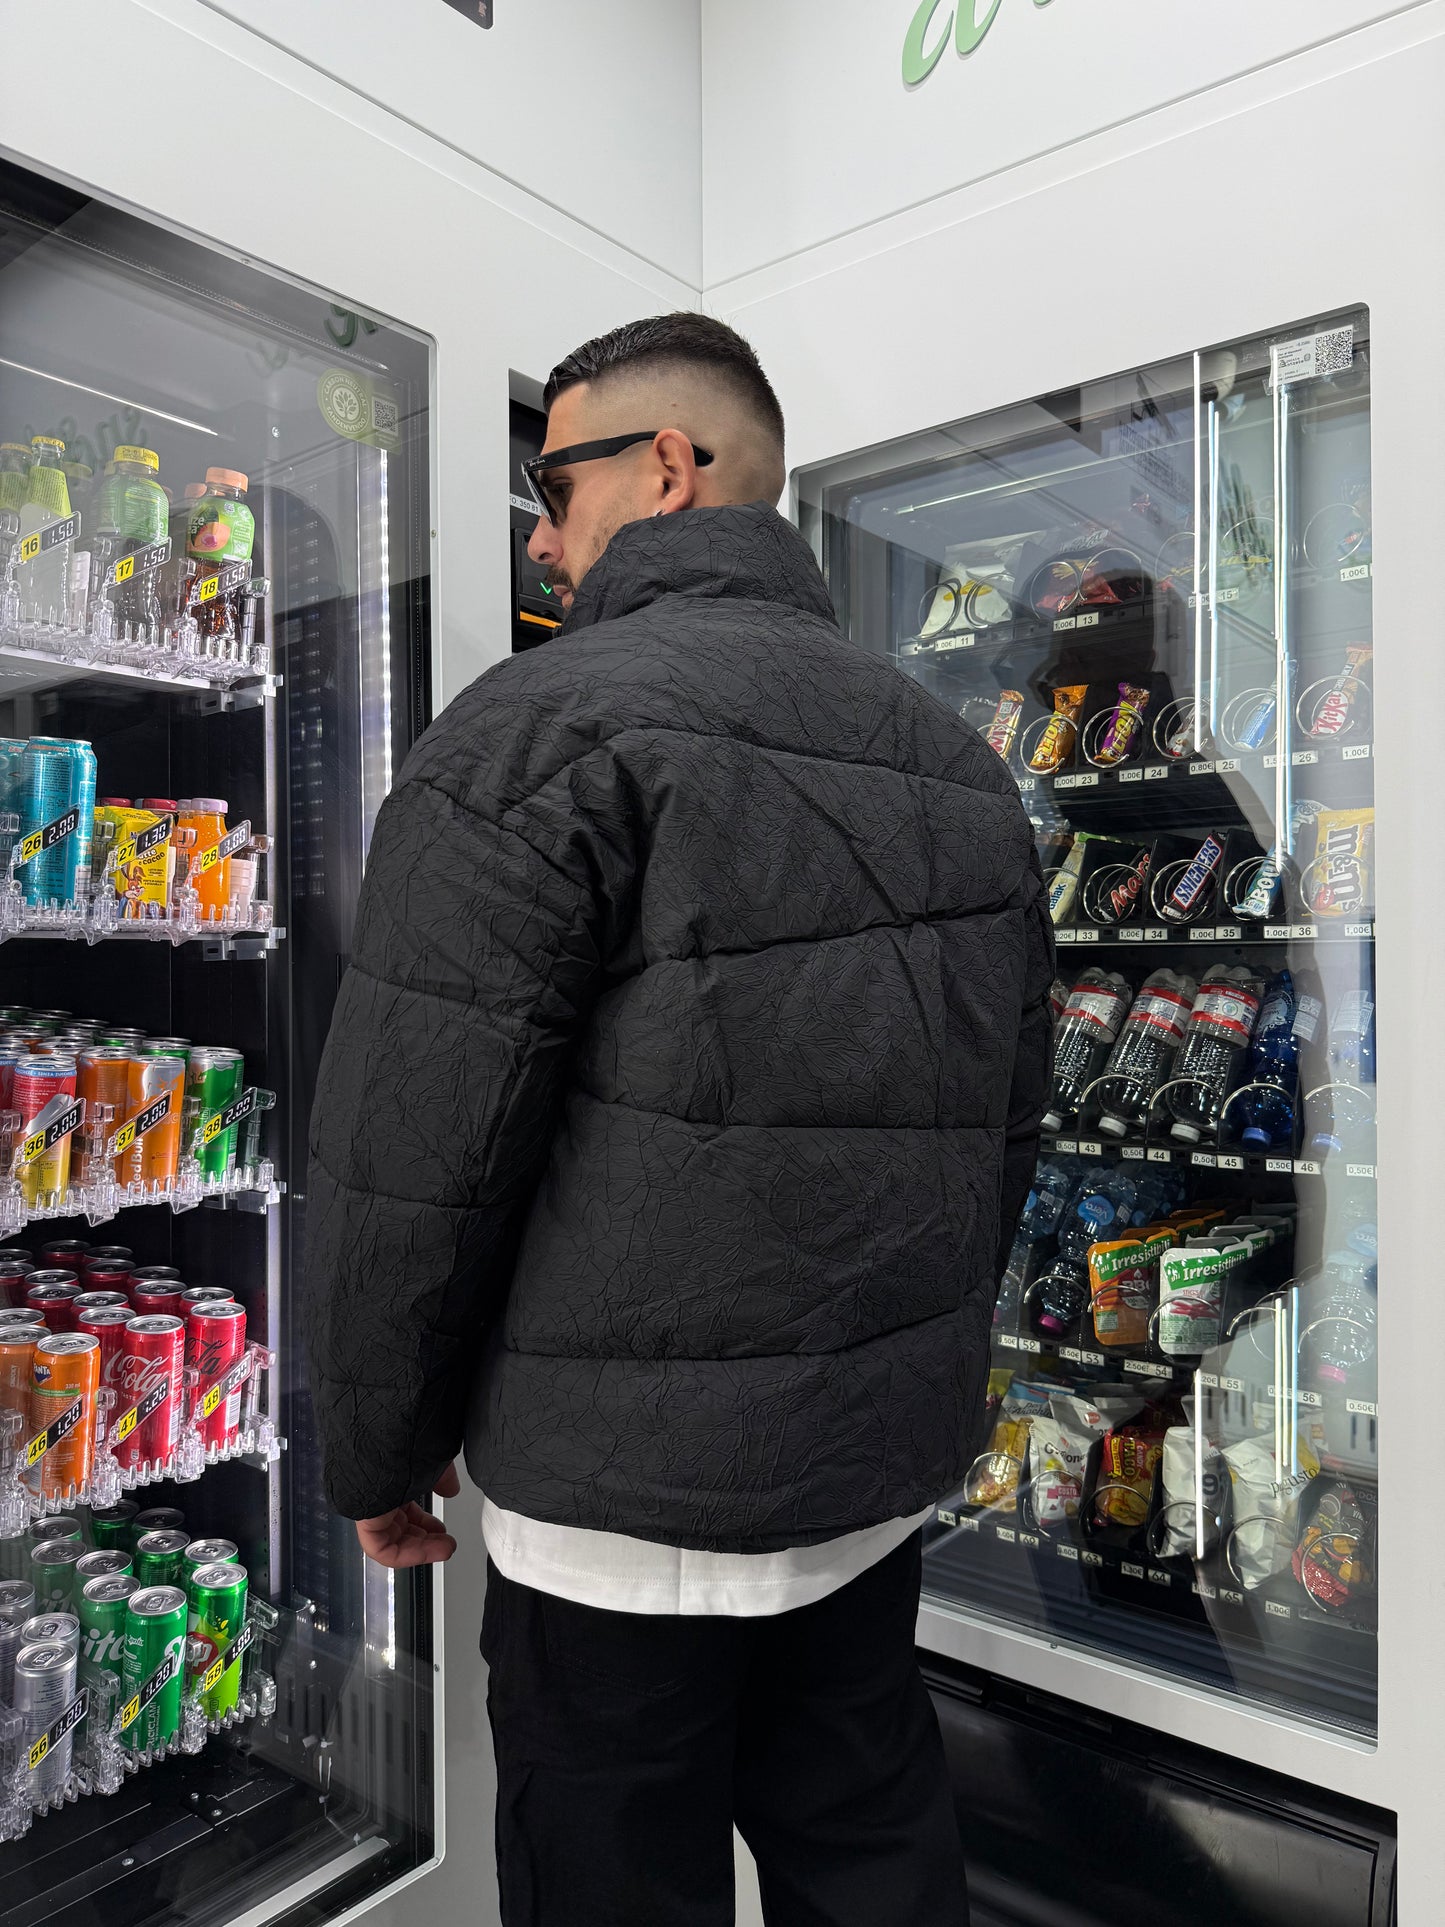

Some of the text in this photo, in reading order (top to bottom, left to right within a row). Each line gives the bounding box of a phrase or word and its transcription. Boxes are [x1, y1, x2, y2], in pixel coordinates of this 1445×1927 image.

[519, 500, 531, 510] 350
[23, 520, 74, 556] 16 1.50
[119, 546, 166, 576] 17 1.50
[203, 566, 245, 595] 18 1.50
[1221, 591, 1232, 600] 15
[1083, 616, 1093, 625] 13
[961, 637, 969, 646] 11
[1315, 692, 1348, 732] KitKat
[1299, 753, 1312, 763] 26
[1222, 761, 1235, 771] 25
[1151, 768, 1162, 778] 24
[1020, 780, 1033, 790] 22
[1081, 775, 1093, 785] 23
[25, 814, 75, 856] 26 2.00
[119, 824, 166, 862] 27 1.30
[142, 851, 166, 866] cacao
[203, 848, 217, 866] 28
[1174, 838, 1220, 905] SNICKERS
[1082, 931, 1093, 940] 33
[1151, 930, 1163, 940] 34
[1223, 928, 1236, 938] 35
[1298, 927, 1312, 937] 36
[119, 1100, 167, 1147] 37 2.00
[206, 1097, 250, 1138] 38 2.00
[26, 1110, 77, 1157] 36 2.00
[1084, 1144, 1096, 1153] 43
[1153, 1151, 1165, 1161] 44
[1224, 1157, 1237, 1168] 45
[1300, 1162, 1314, 1173] 46
[1111, 1237, 1171, 1272] Irresistibili
[1086, 1353, 1099, 1365] 53
[1155, 1366, 1168, 1377] 54
[1226, 1379, 1239, 1390] 55
[205, 1391, 219, 1411] 48
[1302, 1393, 1316, 1404] 56
[121, 1383, 167, 1434] 47 1.20
[29, 1439, 46, 1459] 46
[57, 1404, 80, 1436] 1.20
[1124, 1439, 1136, 1476] TACO
[1085, 1552, 1099, 1564] 63
[1152, 1571, 1167, 1582] 64
[1225, 1591, 1240, 1603] 65
[207, 1628, 251, 1686] 58 1.00
[123, 1703, 138, 1724] 57
[31, 1742, 47, 1767] 56
